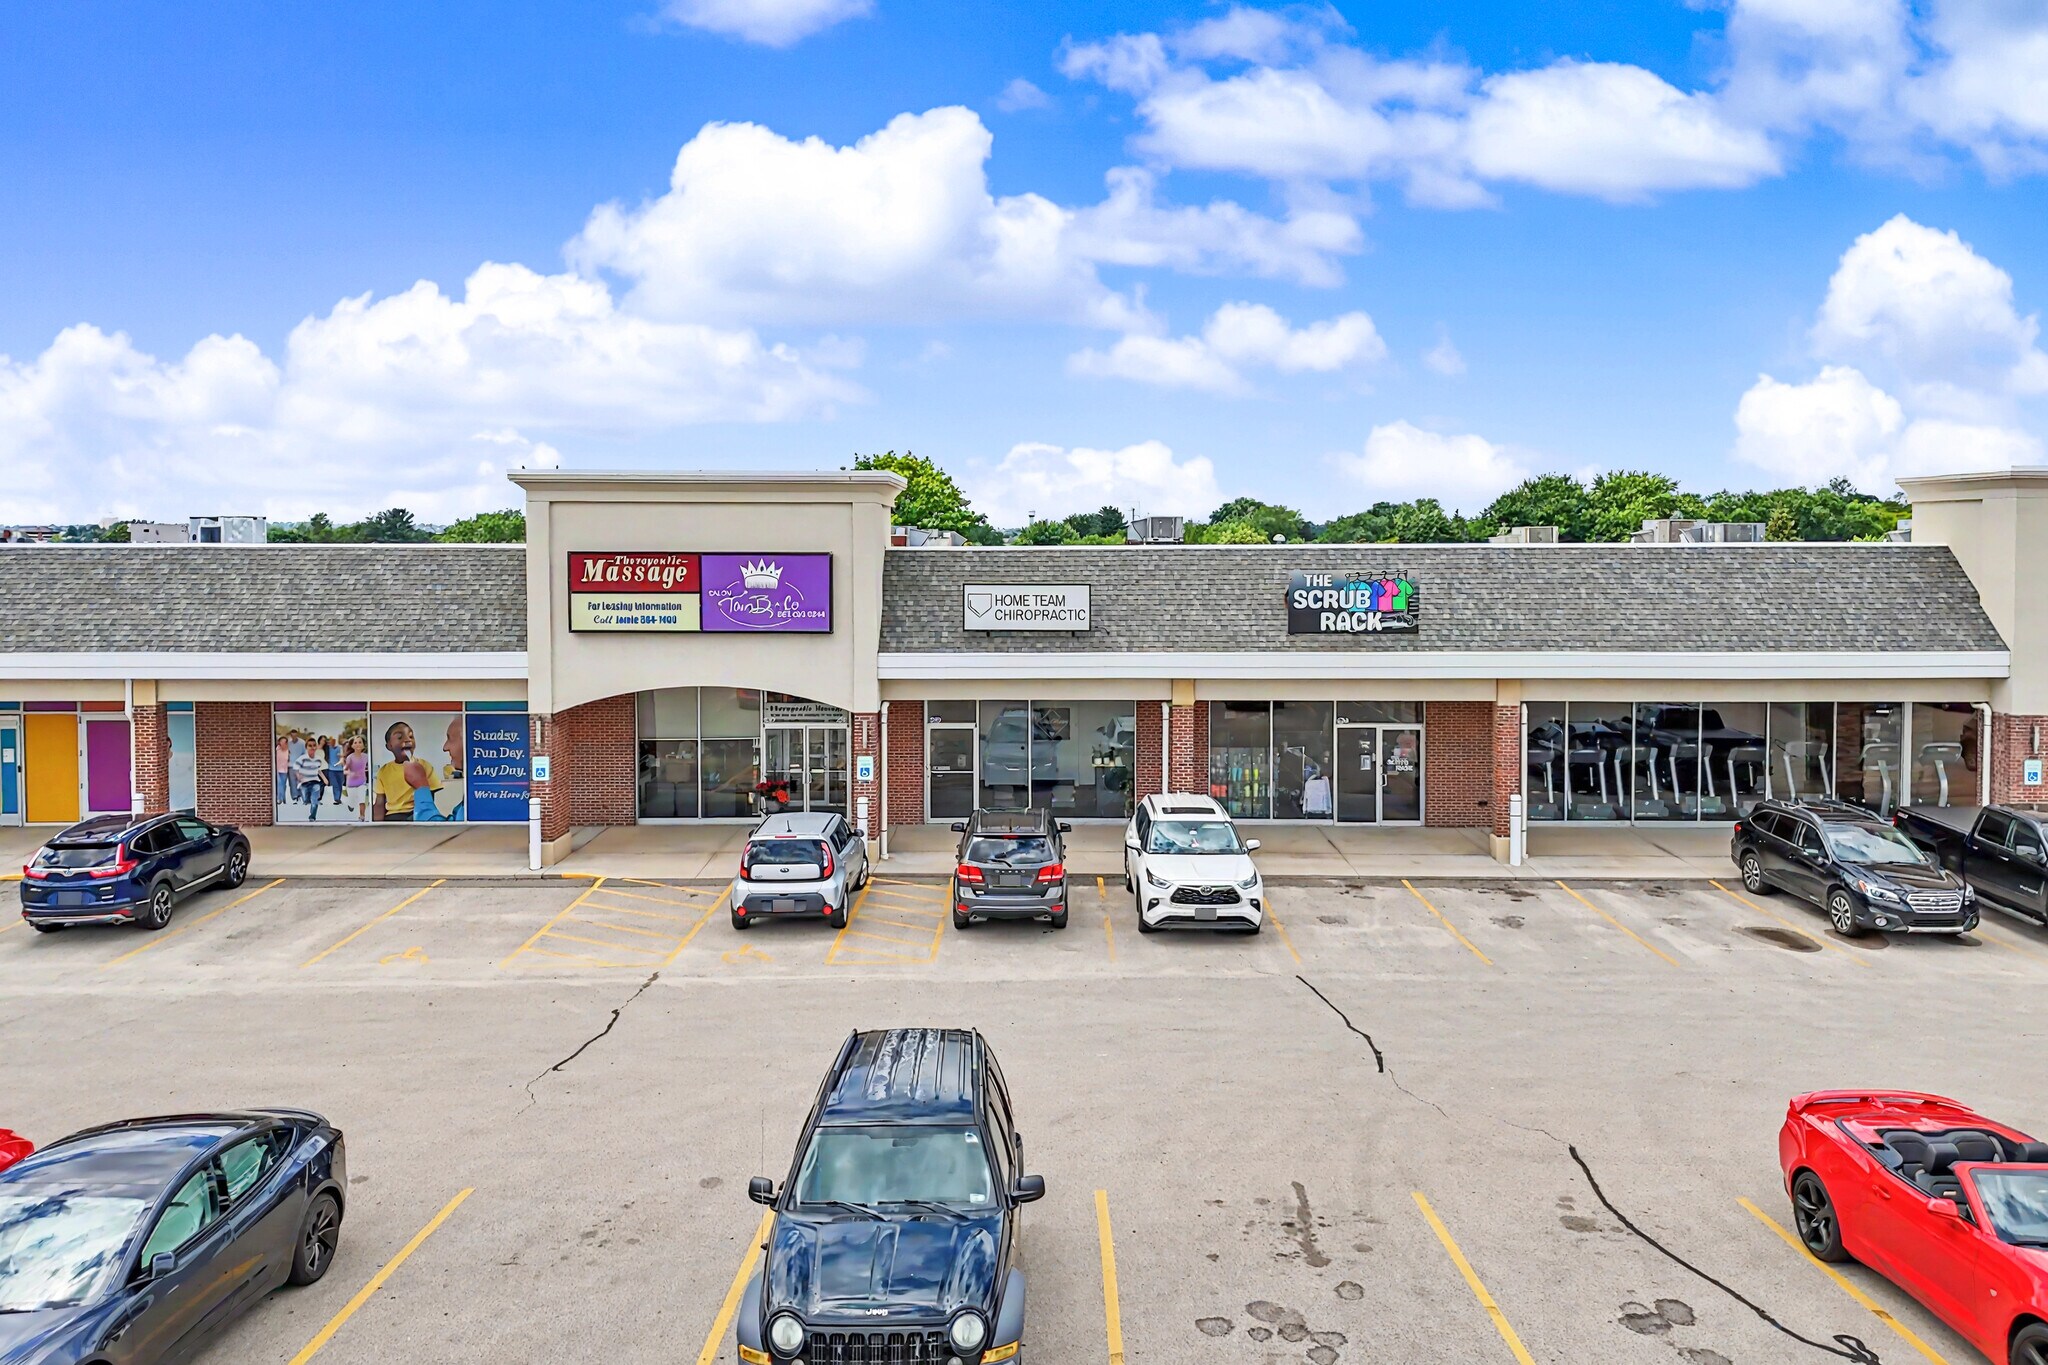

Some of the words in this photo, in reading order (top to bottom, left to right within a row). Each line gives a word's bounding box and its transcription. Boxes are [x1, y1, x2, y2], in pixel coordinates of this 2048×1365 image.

[581, 559, 687, 589] Massage
[1304, 574, 1333, 587] THE
[995, 594, 1030, 607] HOME
[1032, 594, 1066, 607] TEAM
[1293, 589, 1371, 609] SCRUB
[602, 601, 633, 612] Leasing
[593, 614, 613, 624] Call
[994, 609, 1086, 621] CHIROPRACTIC
[1320, 611, 1383, 632] RACK
[473, 747, 498, 759] Fun
[499, 747, 525, 760] Day.
[473, 764, 499, 778] Any
[498, 764, 527, 778] Day.
